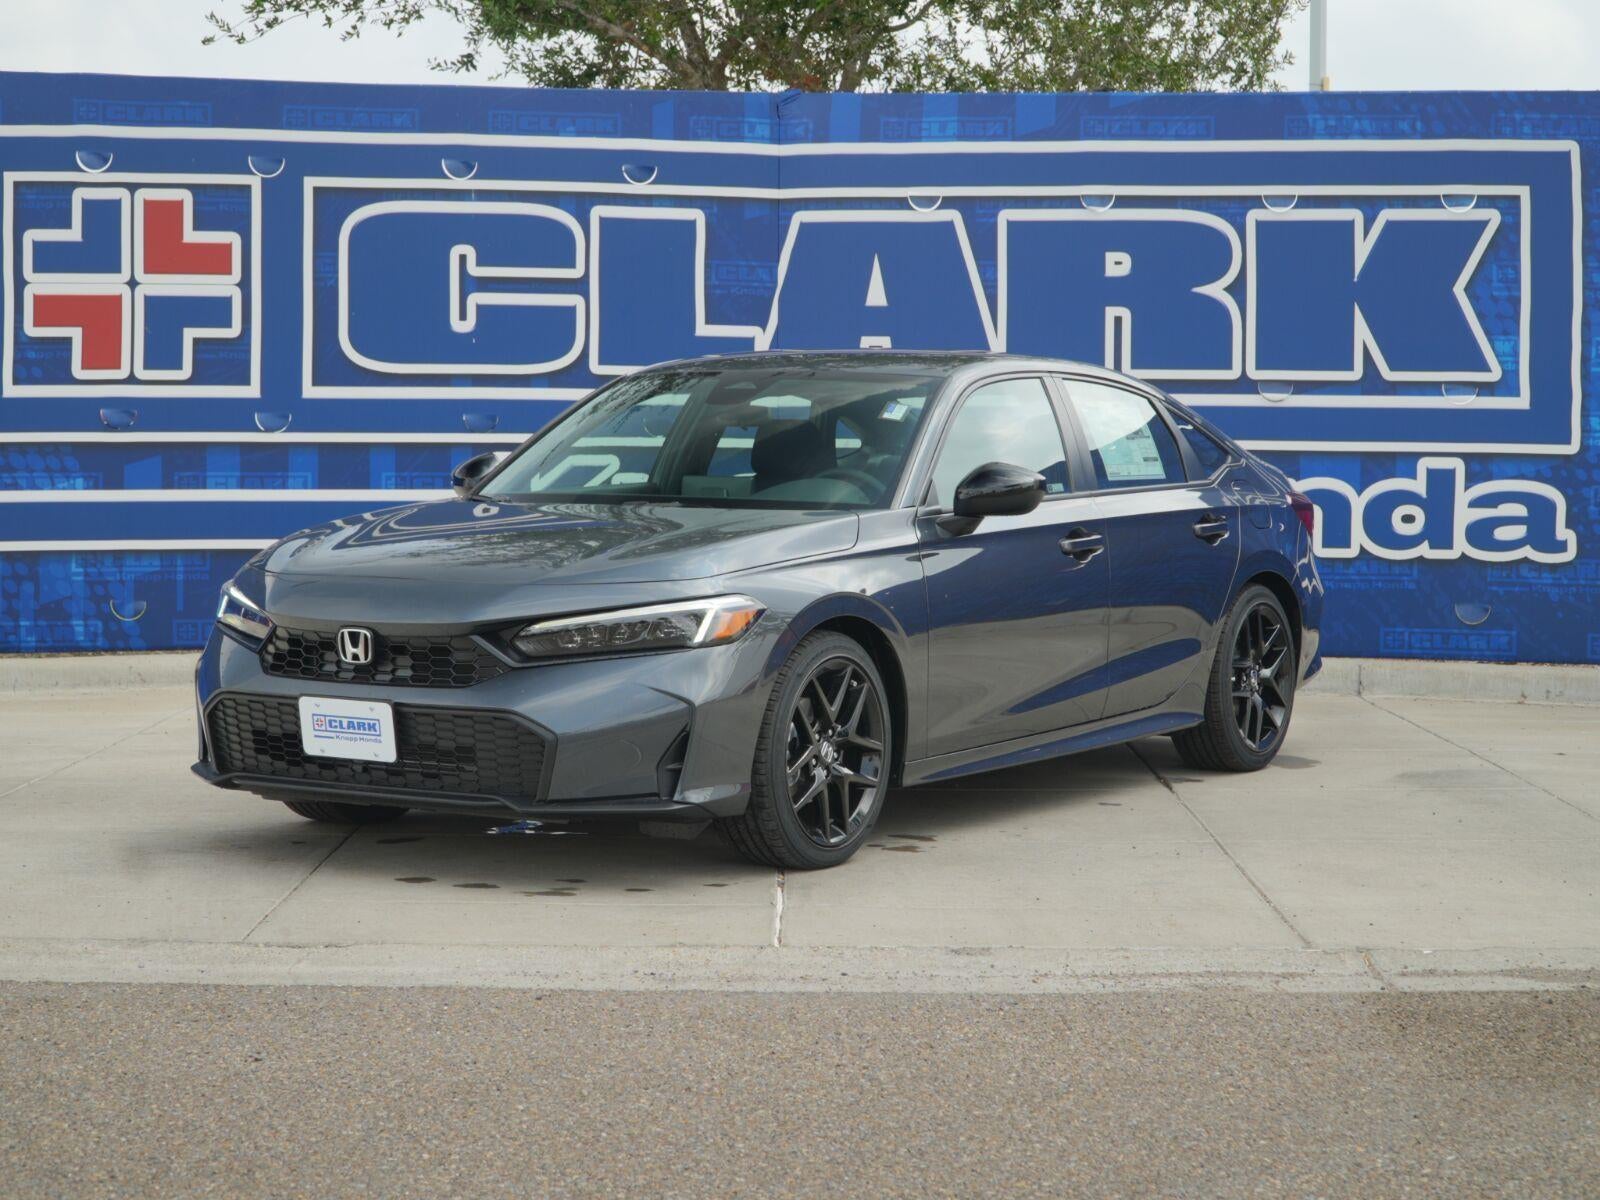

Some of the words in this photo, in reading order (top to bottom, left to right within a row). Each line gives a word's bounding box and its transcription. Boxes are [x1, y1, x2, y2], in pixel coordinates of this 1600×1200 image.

[338, 199, 1502, 383] CLARK
[1288, 456, 1577, 565] nda
[1410, 634, 1511, 650] CLARK
[327, 718, 378, 733] CLARK
[335, 734, 359, 743] Knapp
[359, 736, 383, 744] Honda
